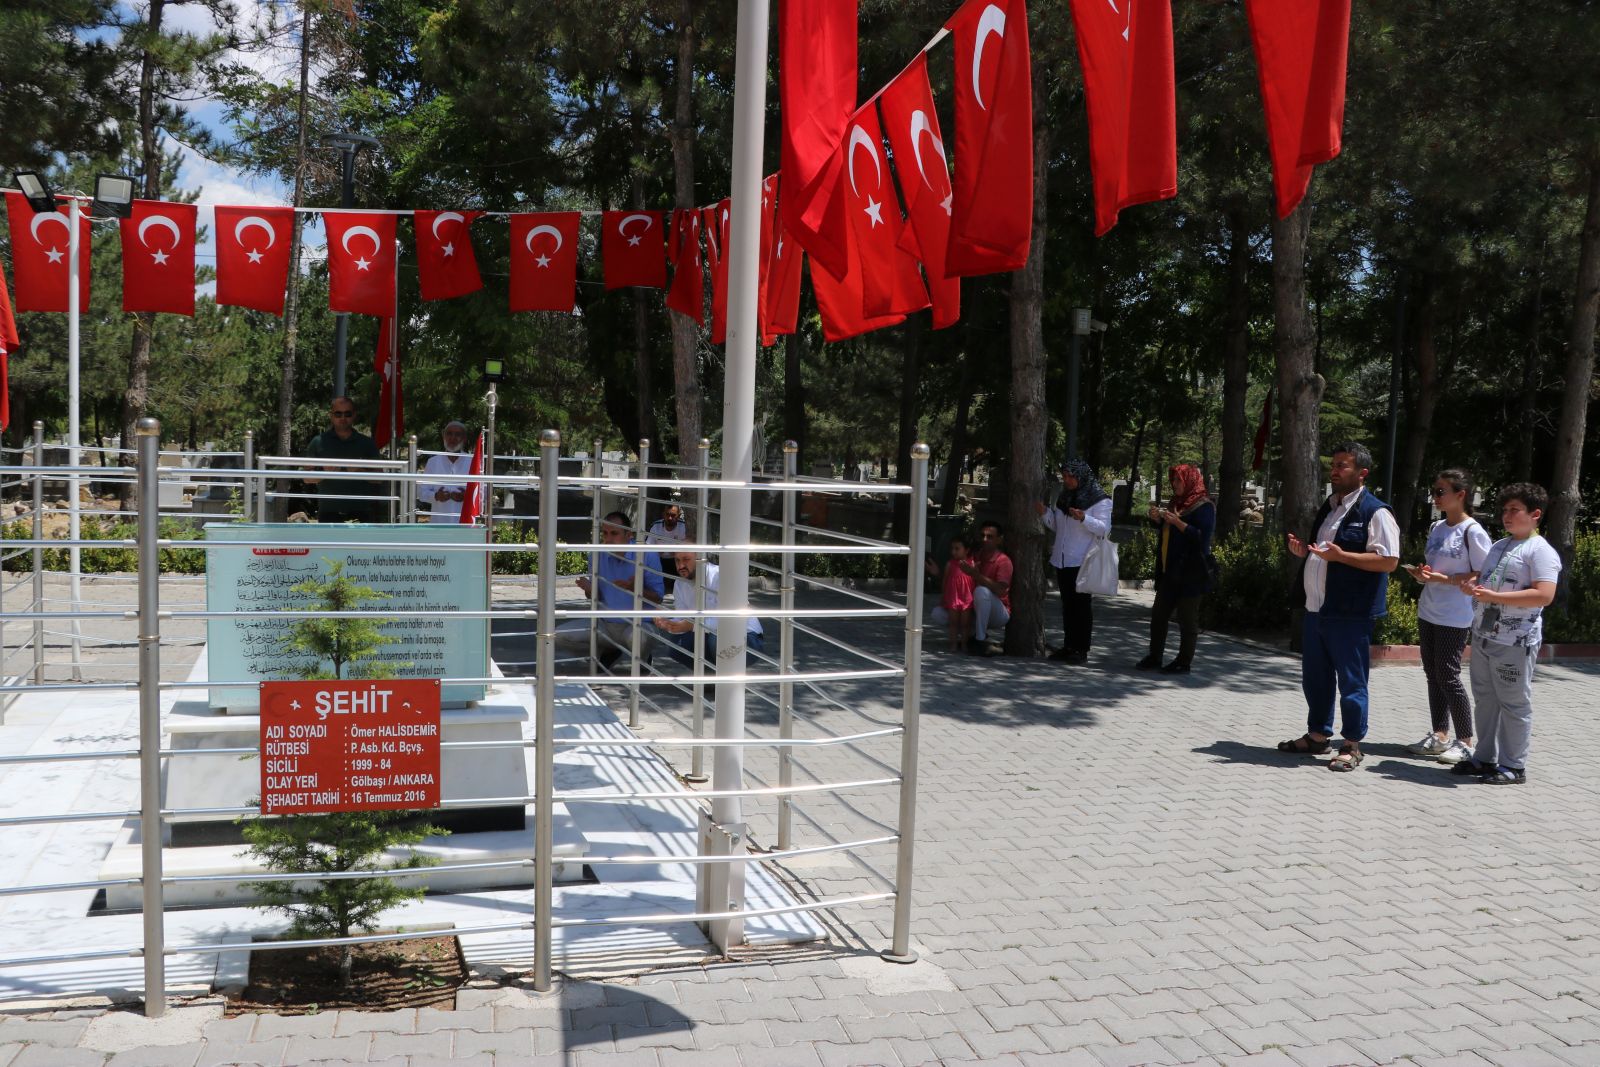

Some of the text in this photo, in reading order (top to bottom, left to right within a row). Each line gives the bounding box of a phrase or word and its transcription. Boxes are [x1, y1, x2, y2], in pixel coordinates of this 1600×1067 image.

[315, 685, 393, 720] ŞEHİT
[266, 726, 284, 739] ADI
[289, 725, 327, 738] SOYADI
[351, 724, 376, 738] Ömer
[378, 722, 437, 737] HALİSDEMİR
[266, 740, 309, 756] RÜTBESİ
[351, 742, 358, 754] P.
[360, 742, 380, 754] Asb.
[382, 742, 397, 753] Kd.
[399, 741, 424, 756] Bçvş.
[266, 757, 298, 773] SİCİLİ
[351, 759, 372, 771] 1999
[380, 758, 392, 770] 84
[266, 776, 293, 790] OLAY
[295, 773, 318, 788] YERİ
[351, 774, 386, 790] Gölbaşı
[393, 773, 434, 786] ANKARA
[266, 792, 309, 813] ŞEHADET
[310, 788, 340, 805] TARİHİ
[351, 792, 362, 804] 16
[364, 791, 402, 803] Temmuz
[404, 790, 426, 802] 2016
